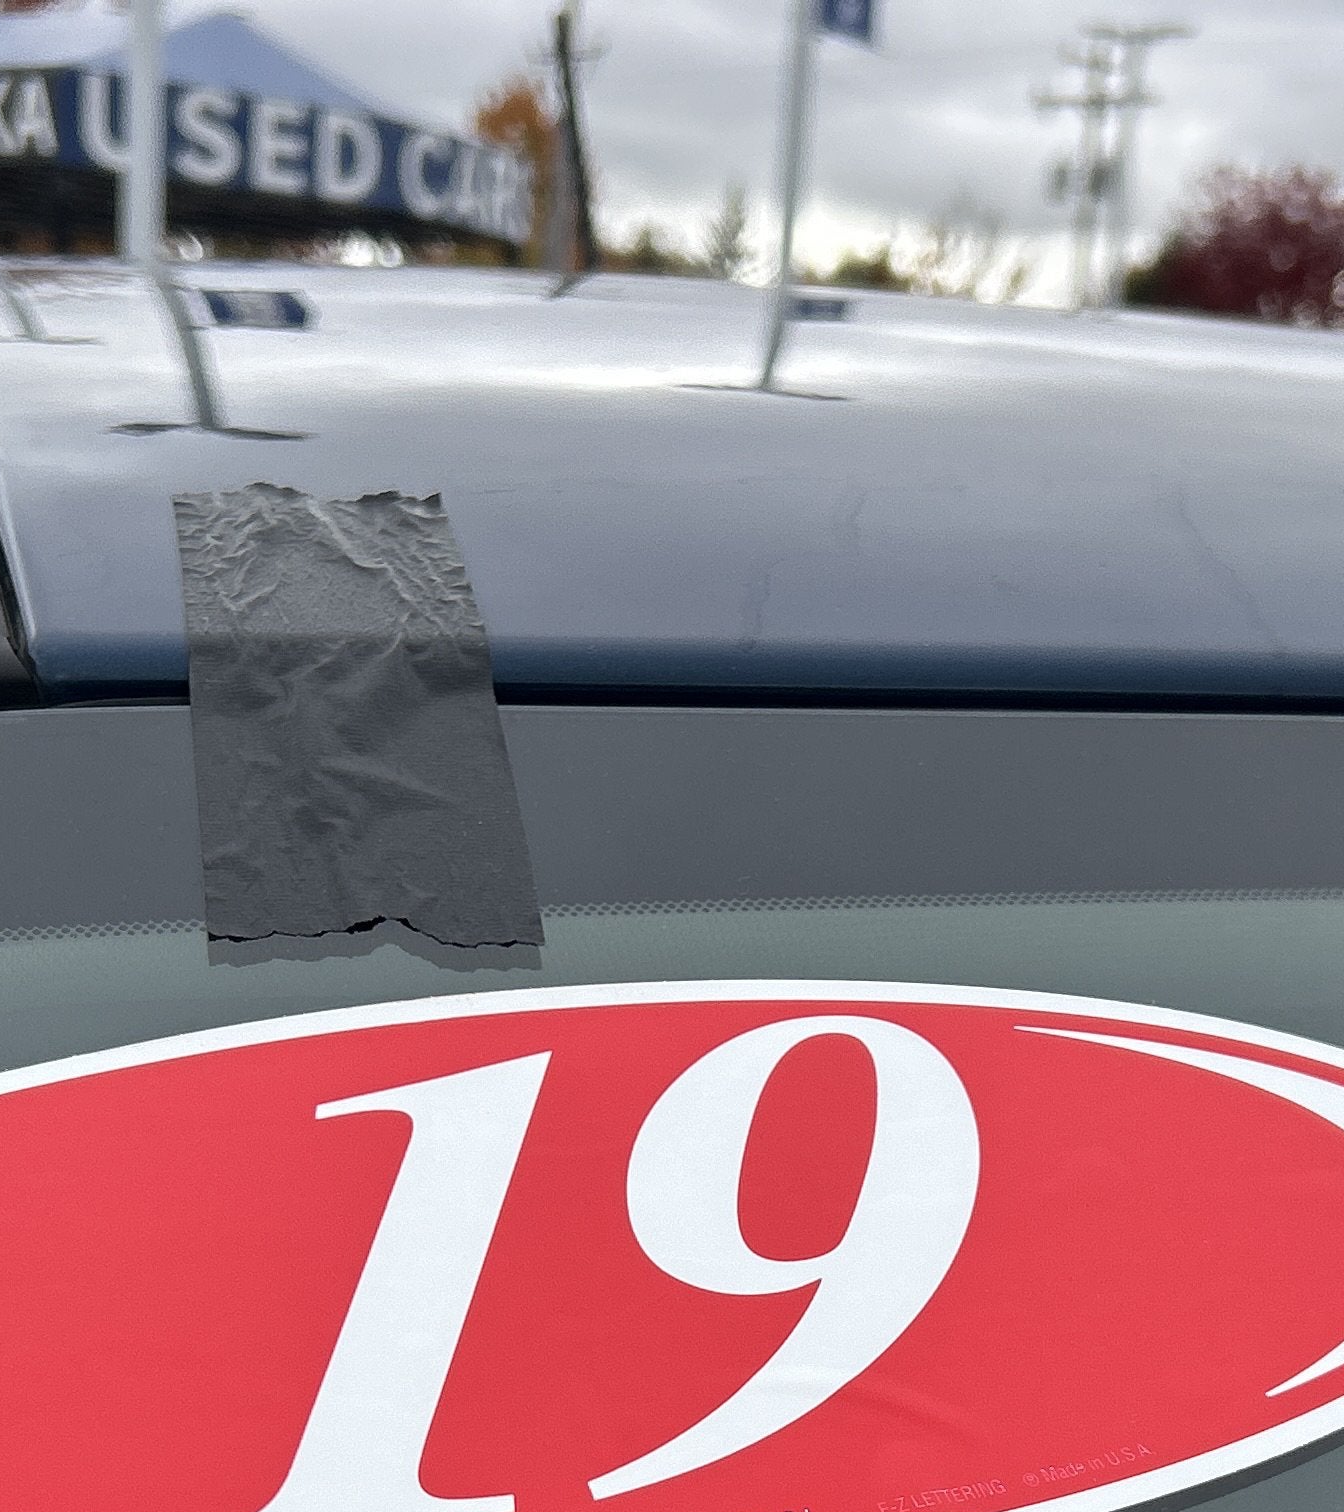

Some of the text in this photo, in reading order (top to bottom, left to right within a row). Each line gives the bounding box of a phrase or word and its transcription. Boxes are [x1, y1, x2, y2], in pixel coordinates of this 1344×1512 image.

[78, 72, 383, 203] USED
[1040, 1462, 1087, 1483] Made
[1087, 1457, 1105, 1471] in
[909, 1478, 1007, 1509] LETTERING
